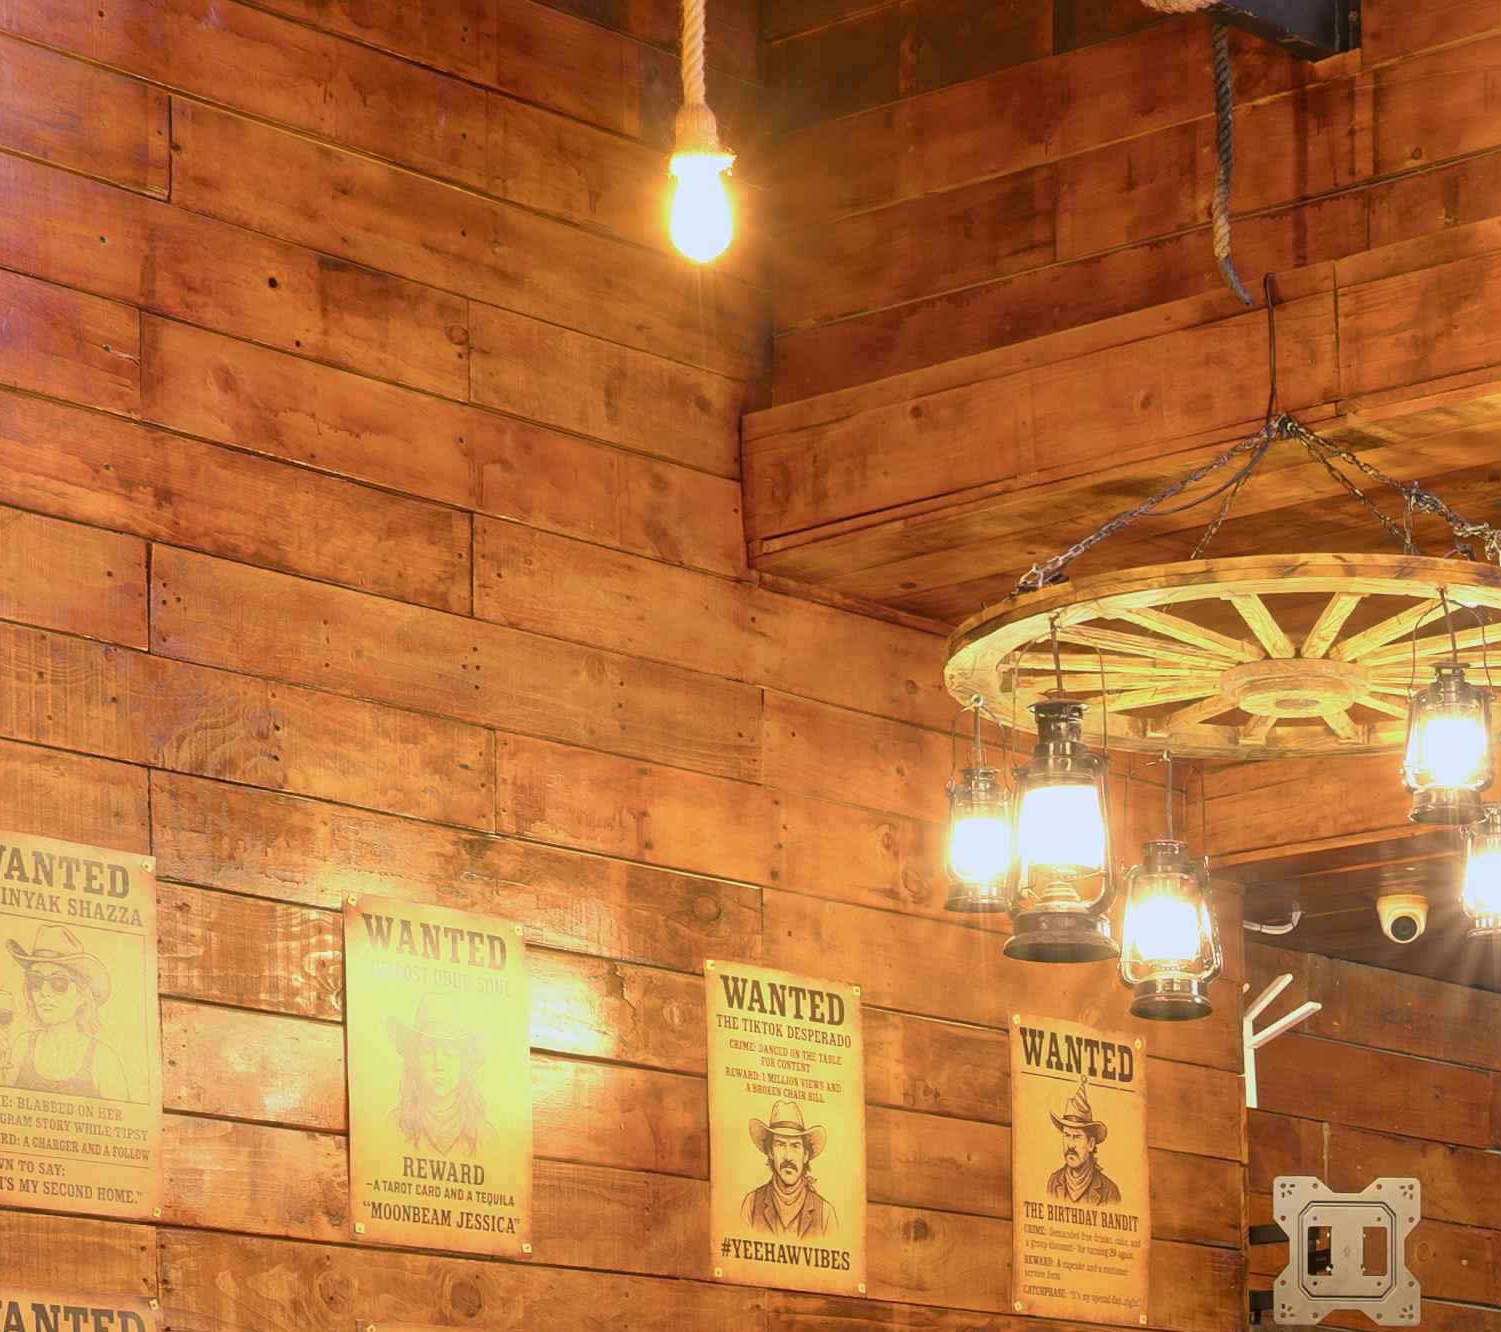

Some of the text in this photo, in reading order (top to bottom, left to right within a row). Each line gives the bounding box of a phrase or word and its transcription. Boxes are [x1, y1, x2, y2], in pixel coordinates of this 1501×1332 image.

[68, 898, 143, 927] SHAZZA
[362, 913, 506, 971] WANTED
[720, 975, 844, 1026] WANTED
[716, 1014, 851, 1048] THE TIKTOK DESPERADO
[1020, 1027, 1133, 1083] WANTED
[19, 1160, 34, 1172] TO
[38, 1163, 65, 1176] SAY:
[403, 1156, 484, 1185] REWARD
[19, 1179, 38, 1193] MY
[43, 1181, 92, 1200] SECOND
[382, 1180, 411, 1194] TAROT
[416, 1186, 441, 1197] CARD
[444, 1188, 464, 1200] AND
[467, 1191, 472, 1201] A
[476, 1192, 514, 1207] TEQUILA
[1024, 1201, 1139, 1232] THE BIRTHDAY BANDIT
[721, 1237, 850, 1271] #YEEHAWVIBES
